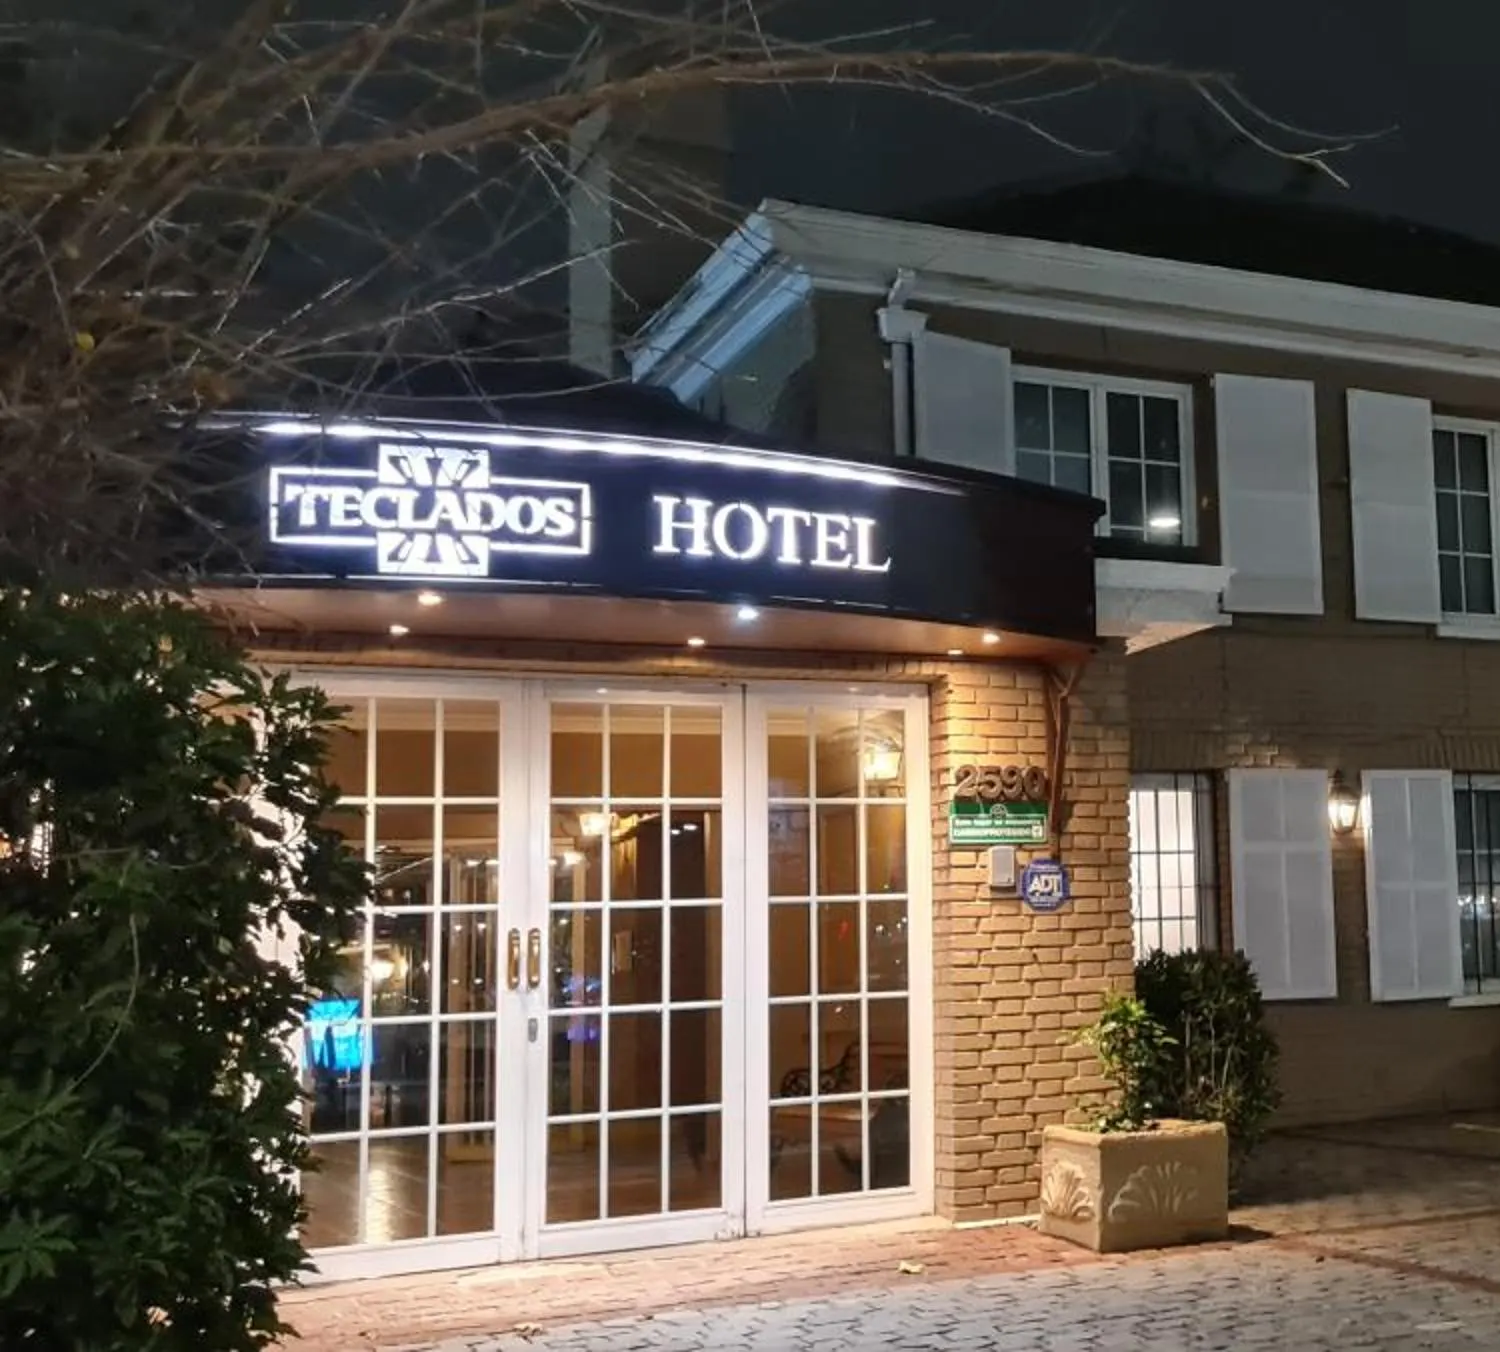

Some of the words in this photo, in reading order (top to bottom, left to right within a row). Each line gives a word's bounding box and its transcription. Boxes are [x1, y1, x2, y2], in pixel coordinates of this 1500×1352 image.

[284, 483, 576, 537] TECLADOS
[652, 494, 893, 573] HOTEL
[954, 764, 1046, 800] 2590
[1028, 873, 1062, 893] ADT
